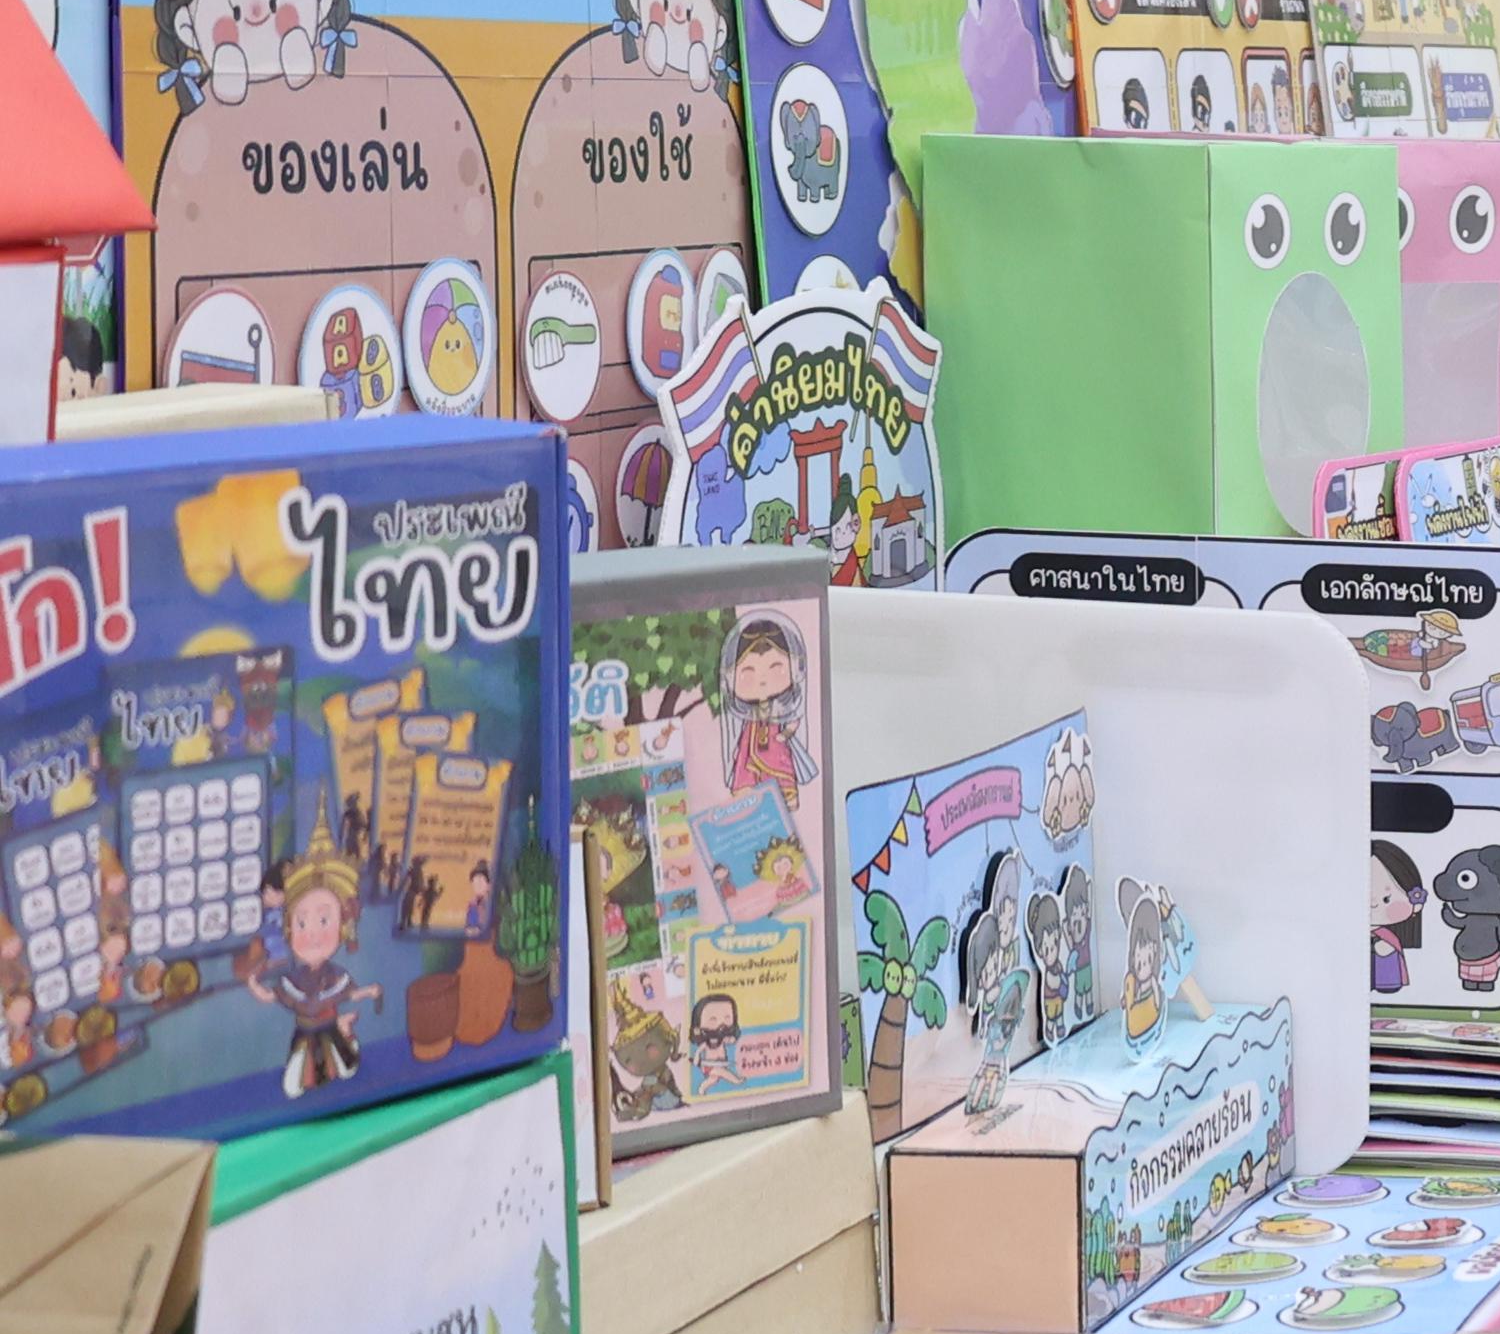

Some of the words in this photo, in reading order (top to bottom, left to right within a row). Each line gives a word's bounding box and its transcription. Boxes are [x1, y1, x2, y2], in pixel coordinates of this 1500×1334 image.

[243, 110, 428, 193] ของเล่น
[584, 107, 693, 183] ของใช้
[728, 343, 908, 473] ค่านิยมไทย
[374, 481, 528, 548] ประเพณี
[282, 490, 537, 658] ไทย
[1029, 560, 1185, 594] ศาสนาในไทย
[1320, 569, 1483, 607] เอกลักษณ์ไทย
[1129, 1087, 1253, 1210] กิจกรรมคลายร้อน
